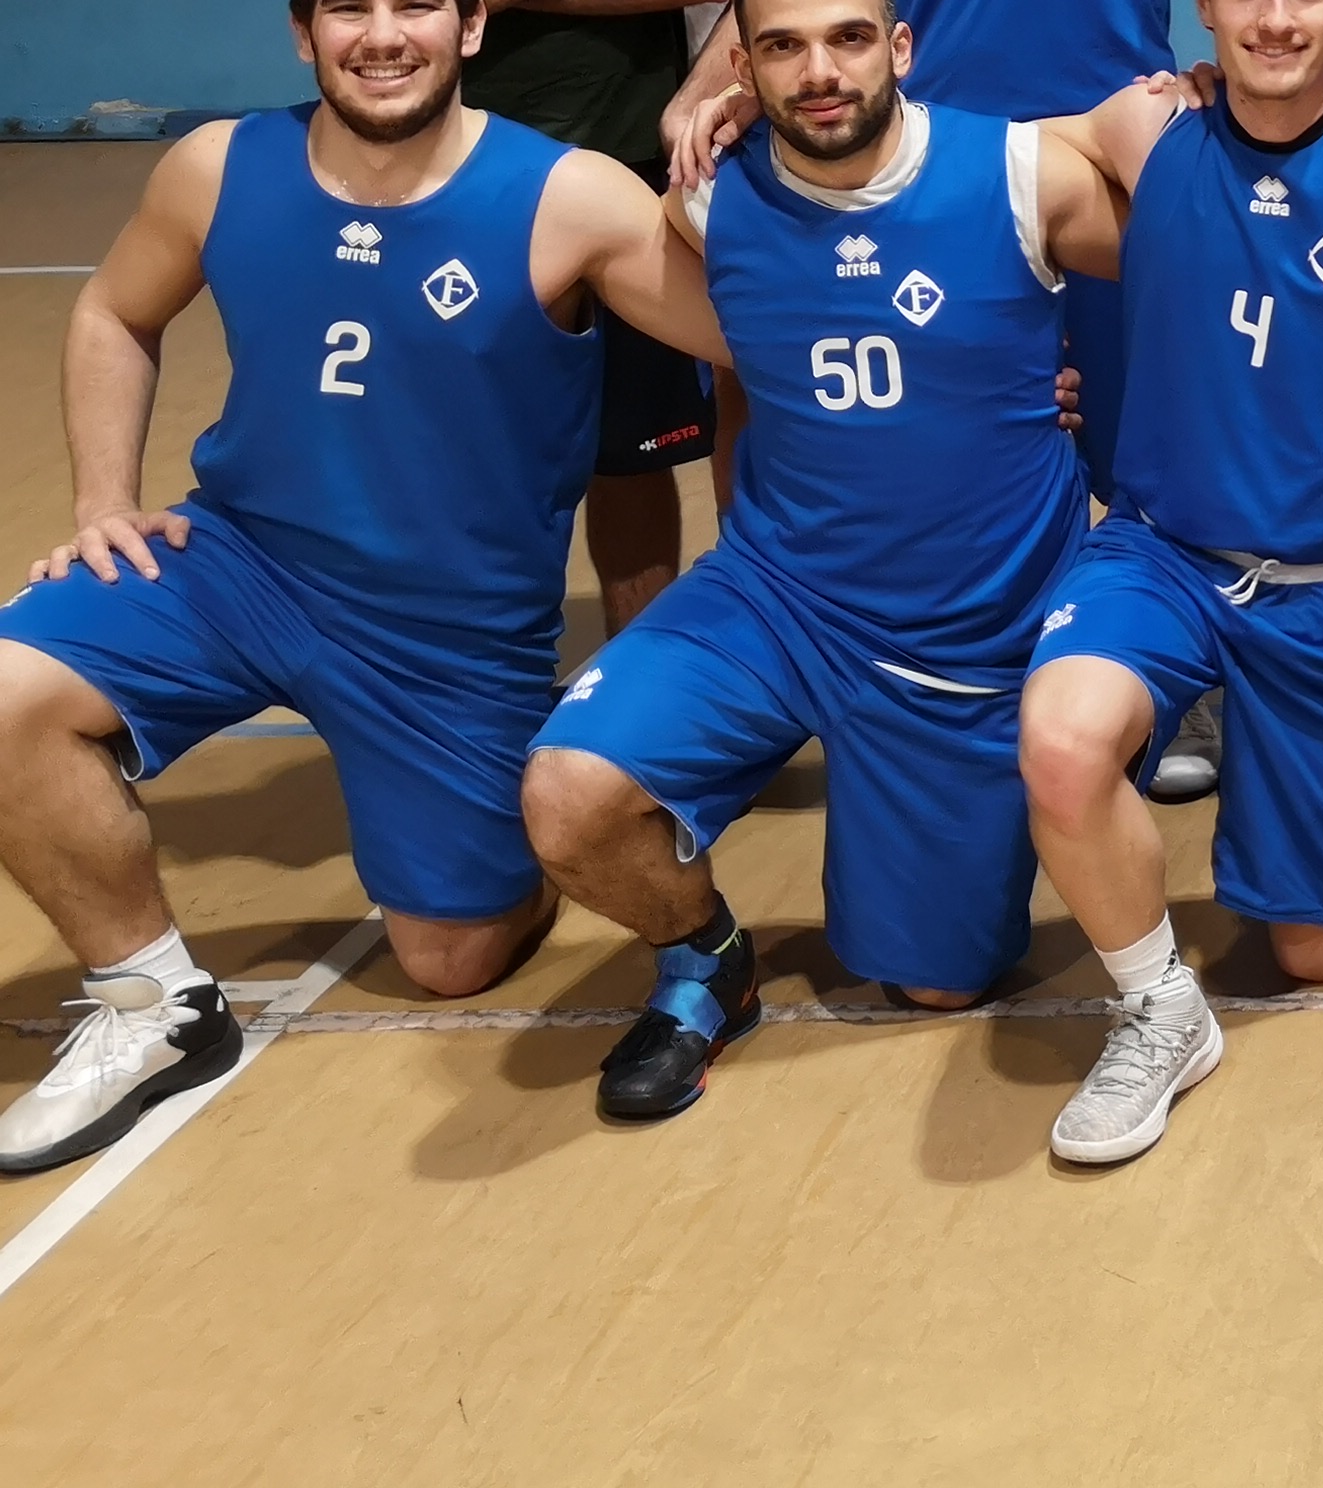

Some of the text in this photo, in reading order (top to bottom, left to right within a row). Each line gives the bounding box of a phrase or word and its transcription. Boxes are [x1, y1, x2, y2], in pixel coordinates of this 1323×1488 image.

[1250, 198, 1290, 217] errea
[336, 243, 381, 265] errea
[836, 259, 881, 278] errea
[1230, 289, 1275, 368] 4
[319, 320, 371, 396] 2
[810, 335, 903, 411] 50
